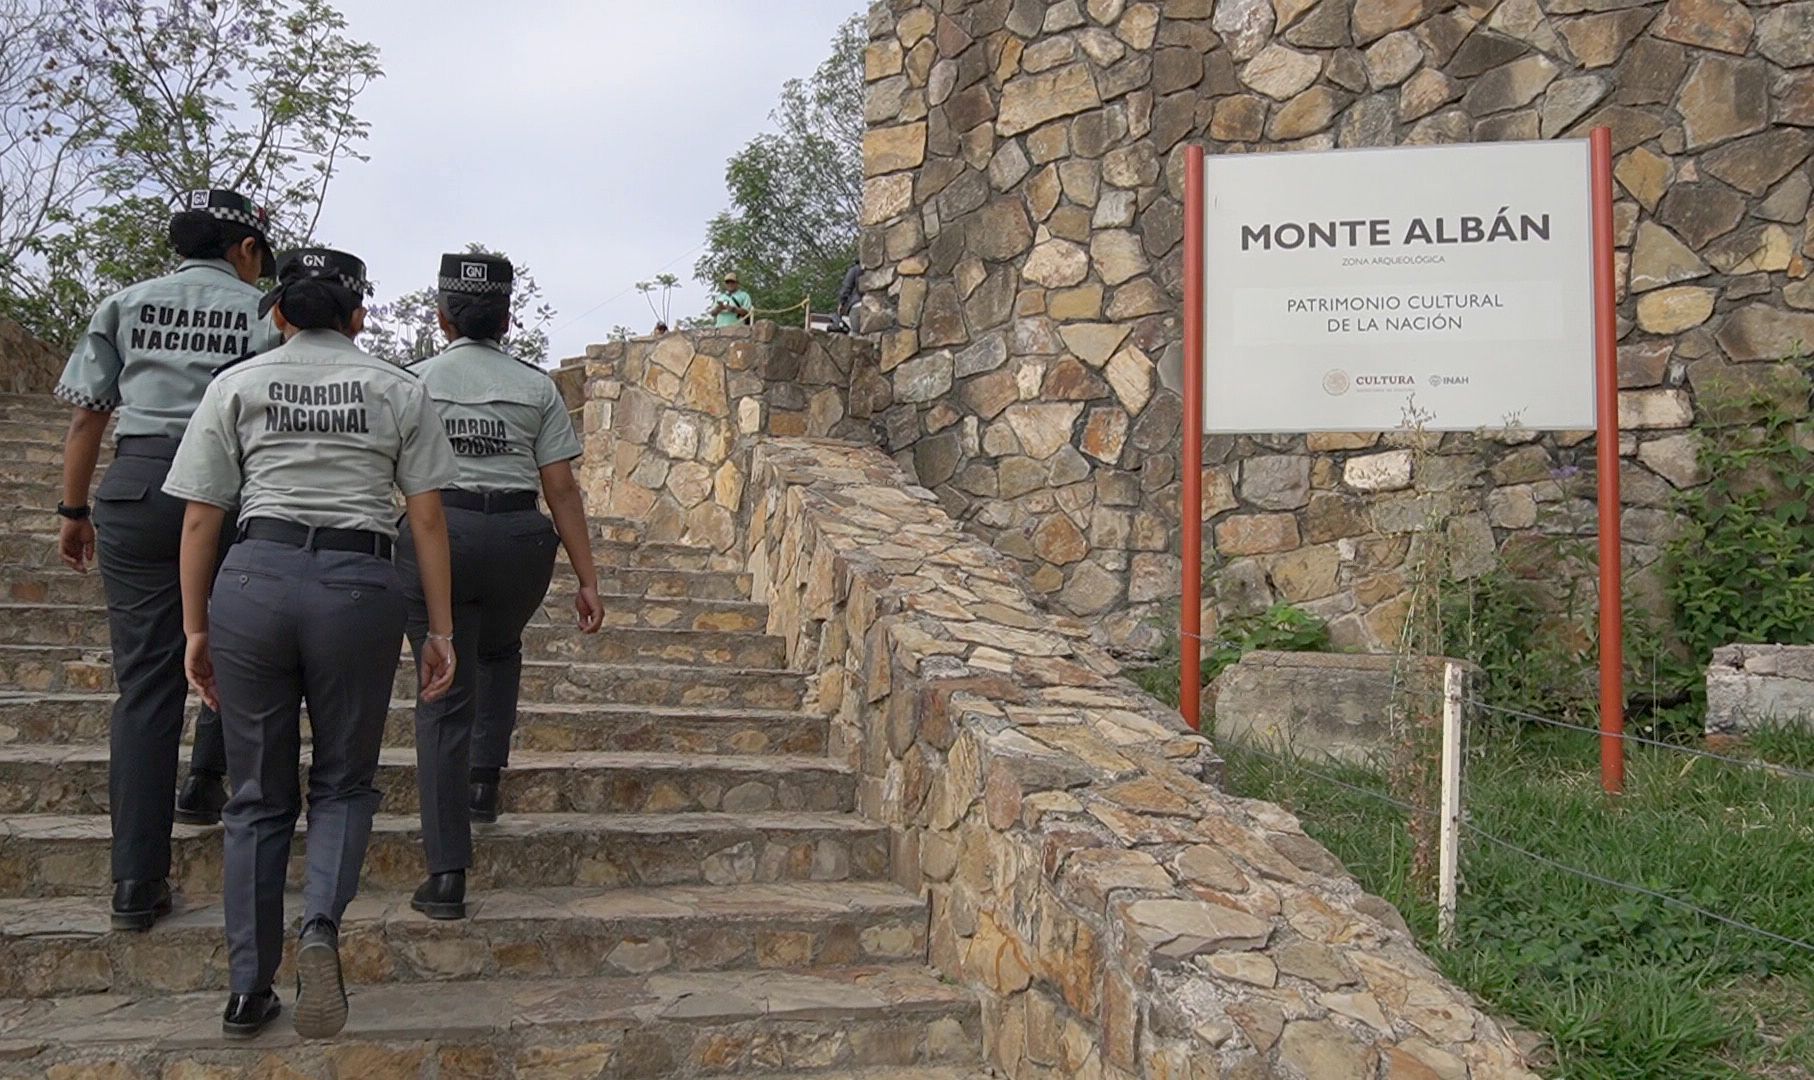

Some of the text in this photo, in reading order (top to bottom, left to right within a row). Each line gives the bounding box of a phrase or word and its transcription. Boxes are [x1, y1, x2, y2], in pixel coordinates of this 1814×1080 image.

[193, 192, 208, 206] GN
[1241, 206, 1550, 251] MONTE ALBÁN
[303, 255, 326, 268] GN
[1342, 255, 1446, 267] ZONA ARQUEOLÓGICA
[465, 266, 483, 278] GN
[1287, 294, 1504, 313] PATRIMONIO CULTURAL
[140, 304, 248, 331] GUARDIA
[1327, 313, 1463, 333] DE LA NACIÓN
[1356, 375, 1470, 386] CULTURA INAH
[268, 381, 364, 406] GUARDIA
[265, 404, 369, 434] NACIONAL
[445, 419, 507, 439] UARDIA
